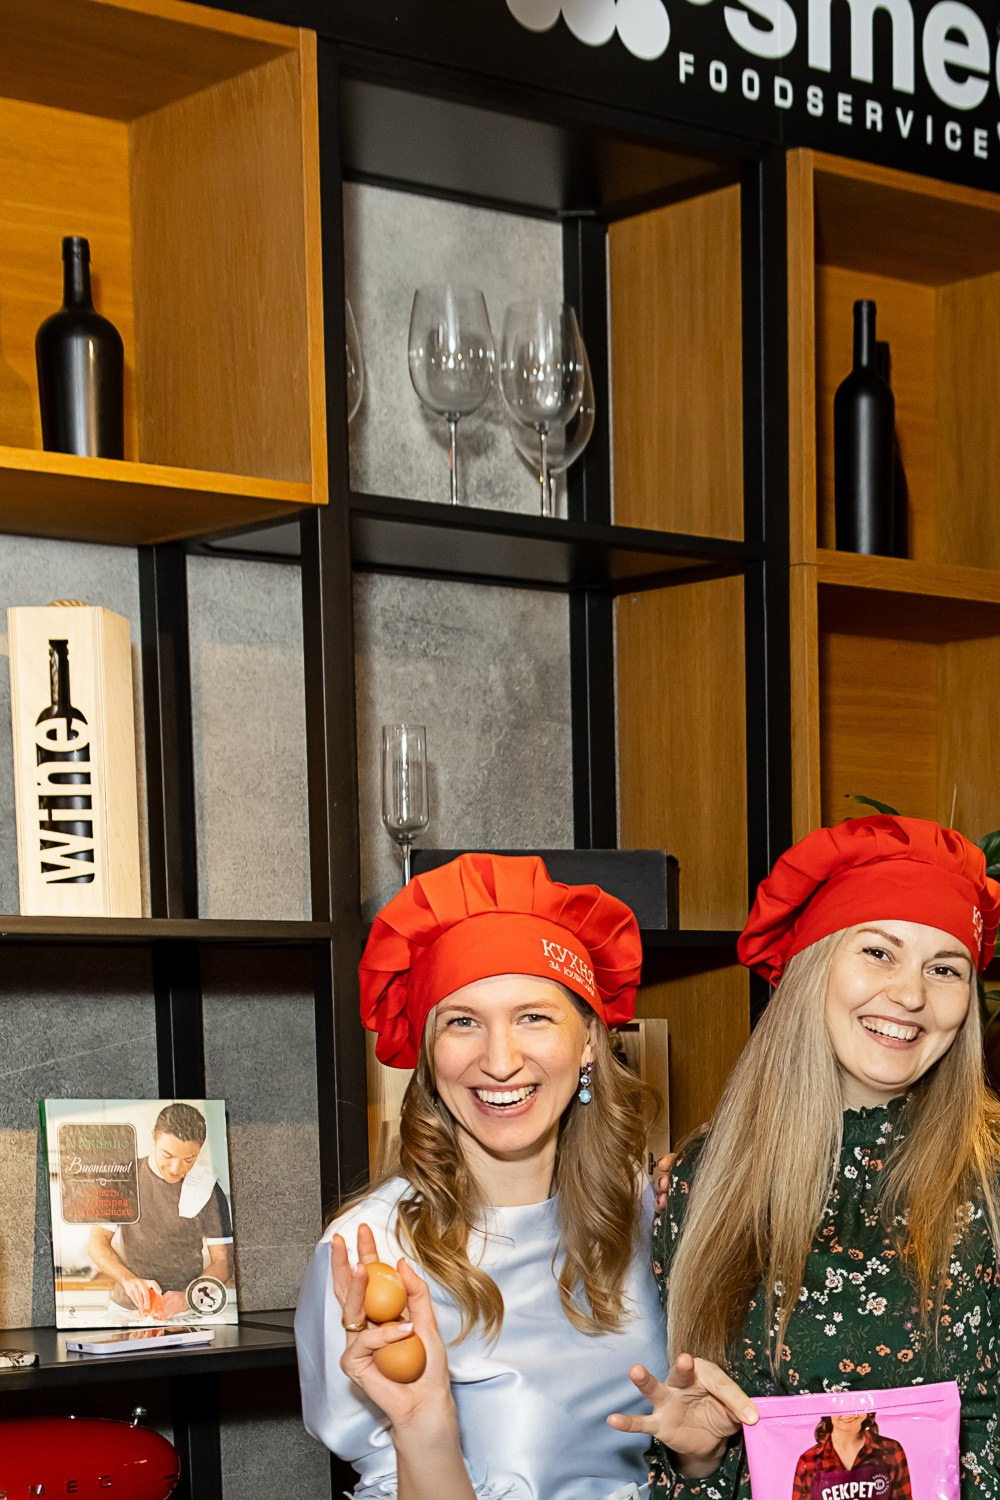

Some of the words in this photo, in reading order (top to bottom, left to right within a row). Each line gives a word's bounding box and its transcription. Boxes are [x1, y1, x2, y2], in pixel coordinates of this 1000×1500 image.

[679, 51, 989, 160] FOODSERVICE
[541, 938, 597, 990] КУХНЯ
[549, 960, 561, 972] ЗА
[64, 1154, 133, 1175] Buonissimo!
